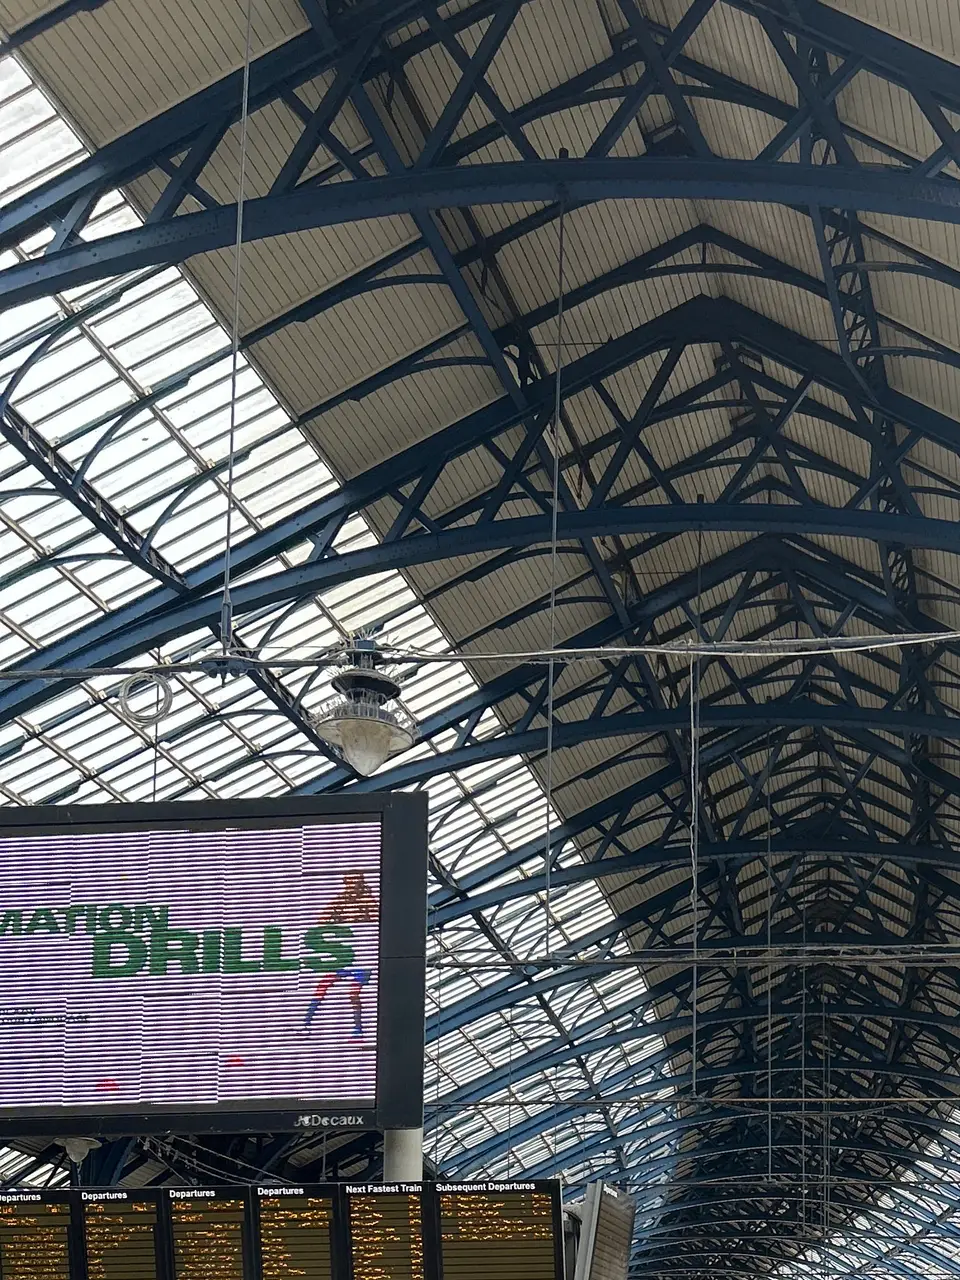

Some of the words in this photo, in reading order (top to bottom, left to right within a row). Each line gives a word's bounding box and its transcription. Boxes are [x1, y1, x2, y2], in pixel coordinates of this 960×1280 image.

[92, 925, 356, 977] DRILLS
[257, 1187, 304, 1196] Departures
[346, 1186, 366, 1194] Next
[368, 1184, 400, 1192] Fastest
[401, 1184, 422, 1192] Train
[436, 1184, 486, 1192] Subsequent
[488, 1182, 536, 1191] Departures
[81, 1192, 128, 1201] Departures
[169, 1190, 216, 1199] Departures
